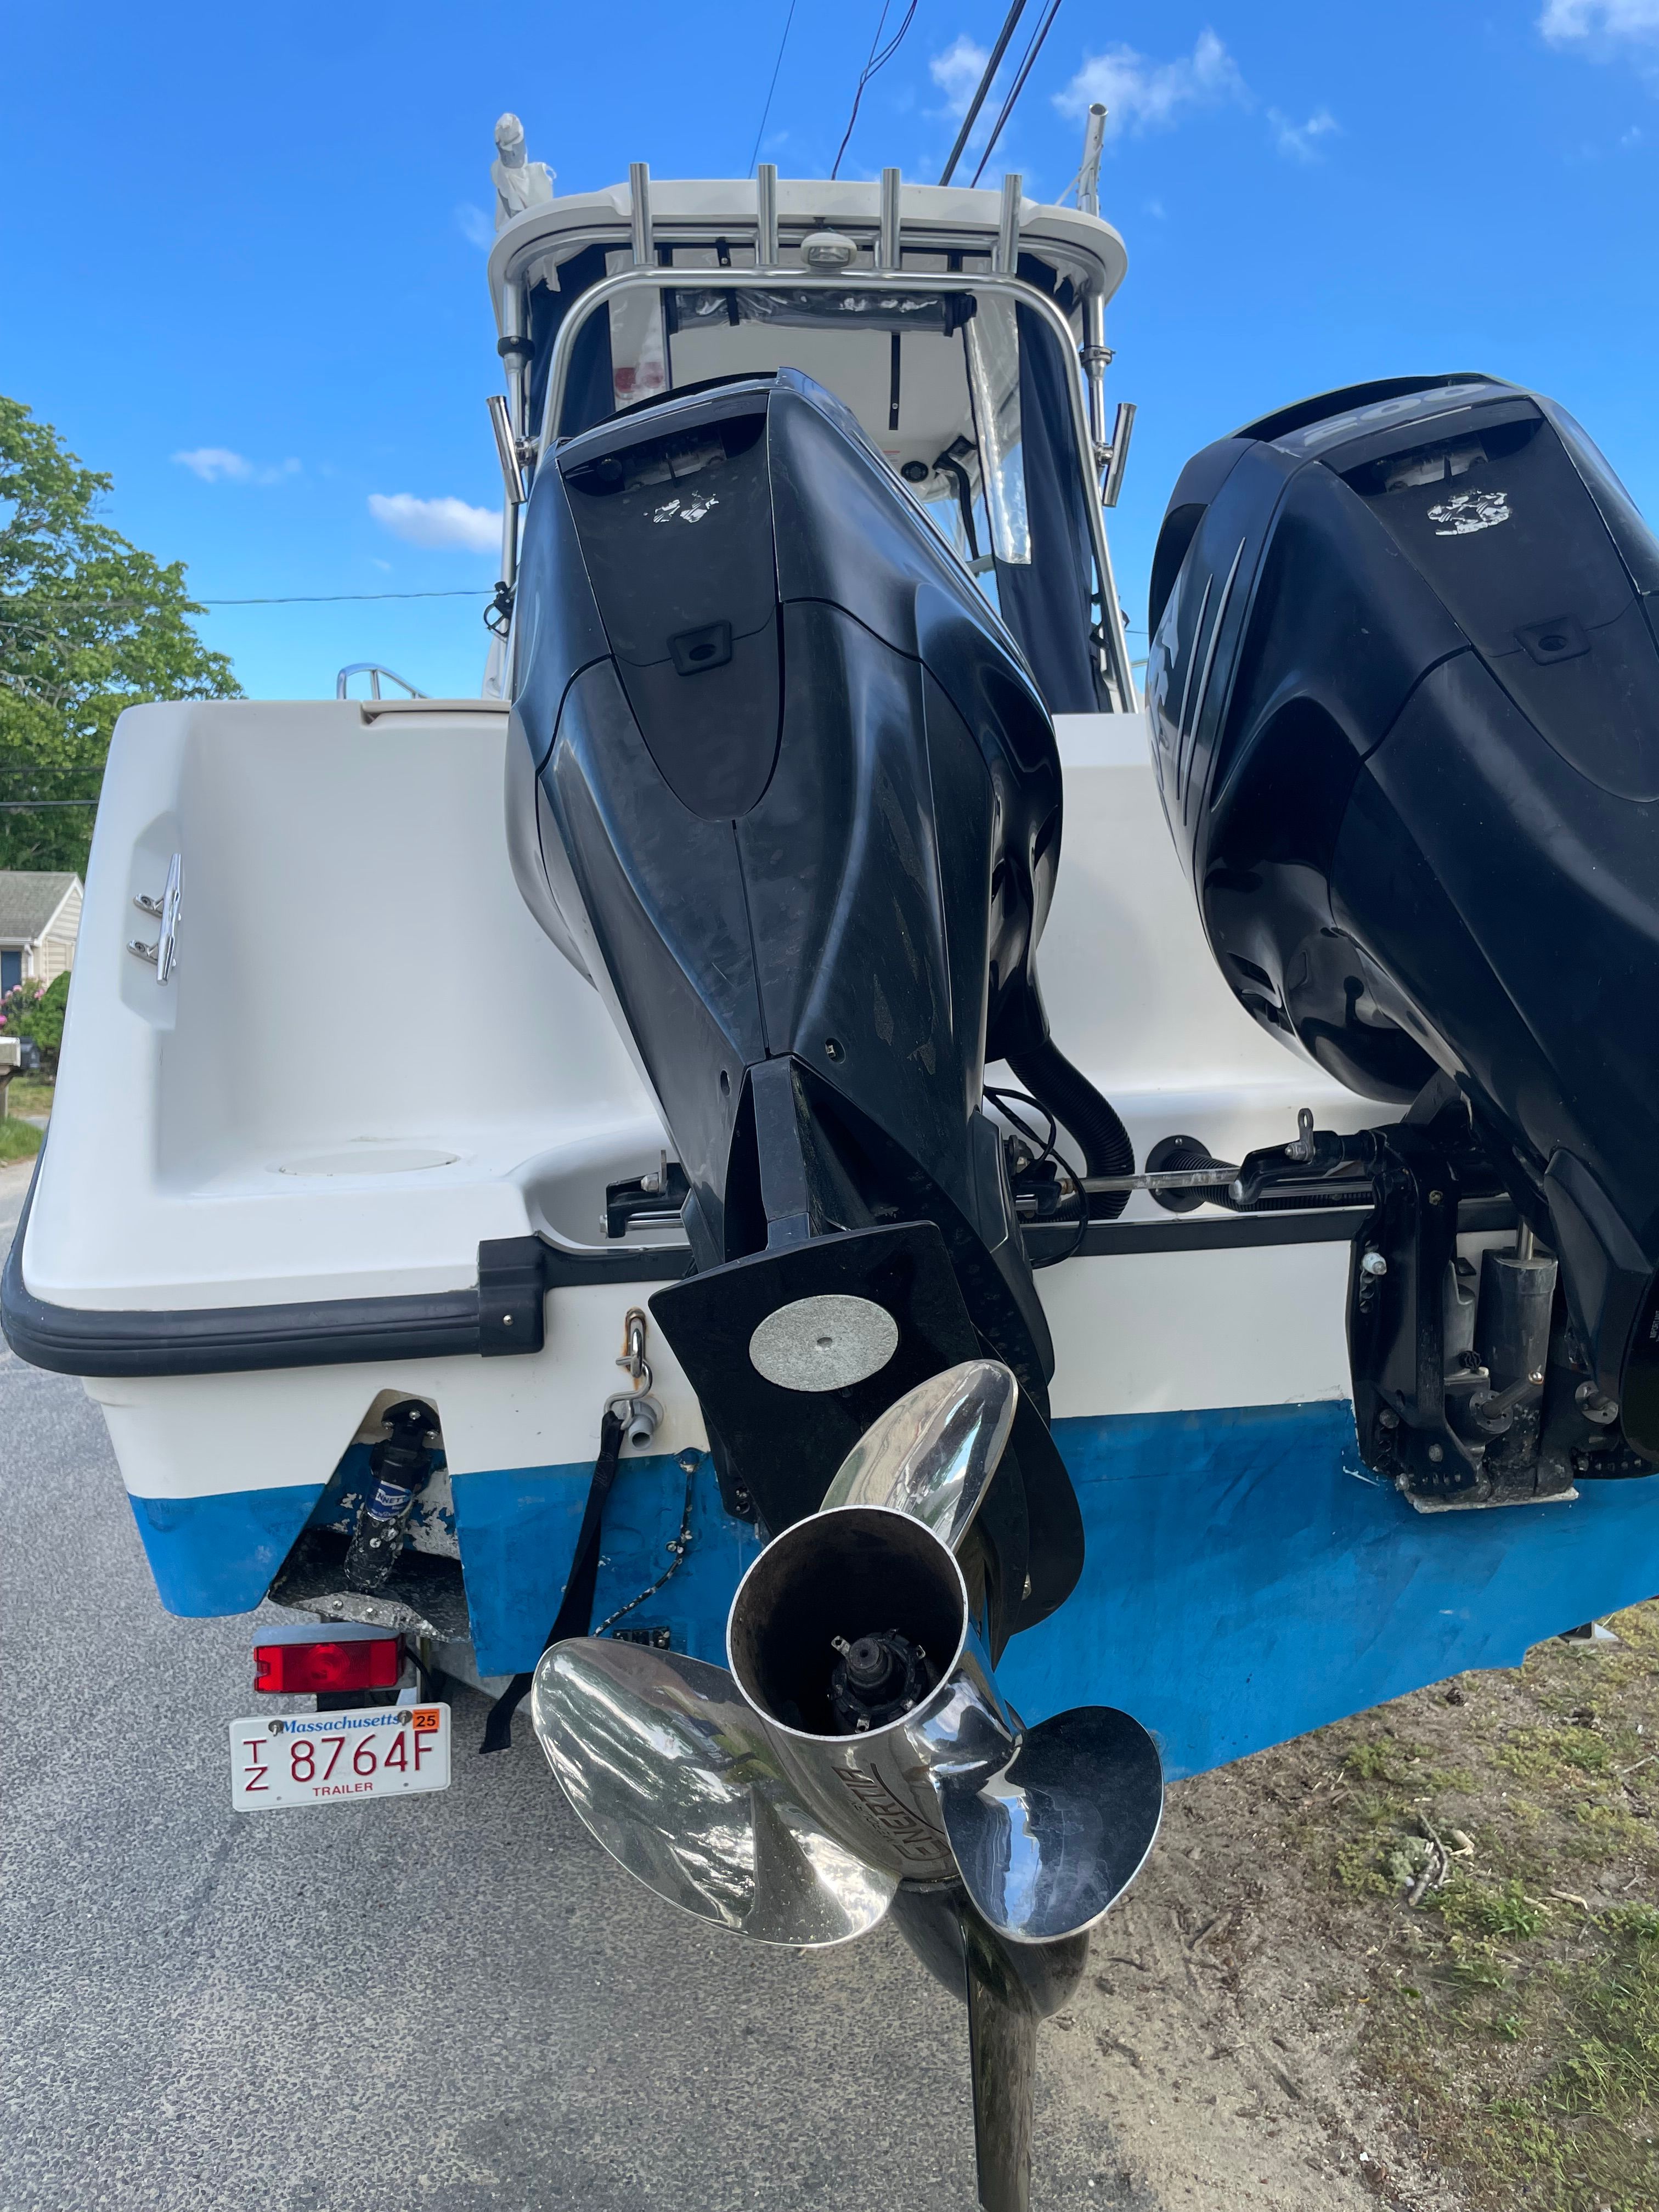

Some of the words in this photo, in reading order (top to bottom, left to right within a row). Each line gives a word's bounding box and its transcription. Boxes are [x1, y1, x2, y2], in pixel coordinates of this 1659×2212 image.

[1303, 383, 1486, 447] 200
[280, 1714, 400, 1734] Massachusetts
[415, 1715, 436, 1727] 25
[290, 1729, 438, 1782] 8764F
[312, 1782, 374, 1797] TRAILER
[831, 1766, 952, 1861] ENERTIA
